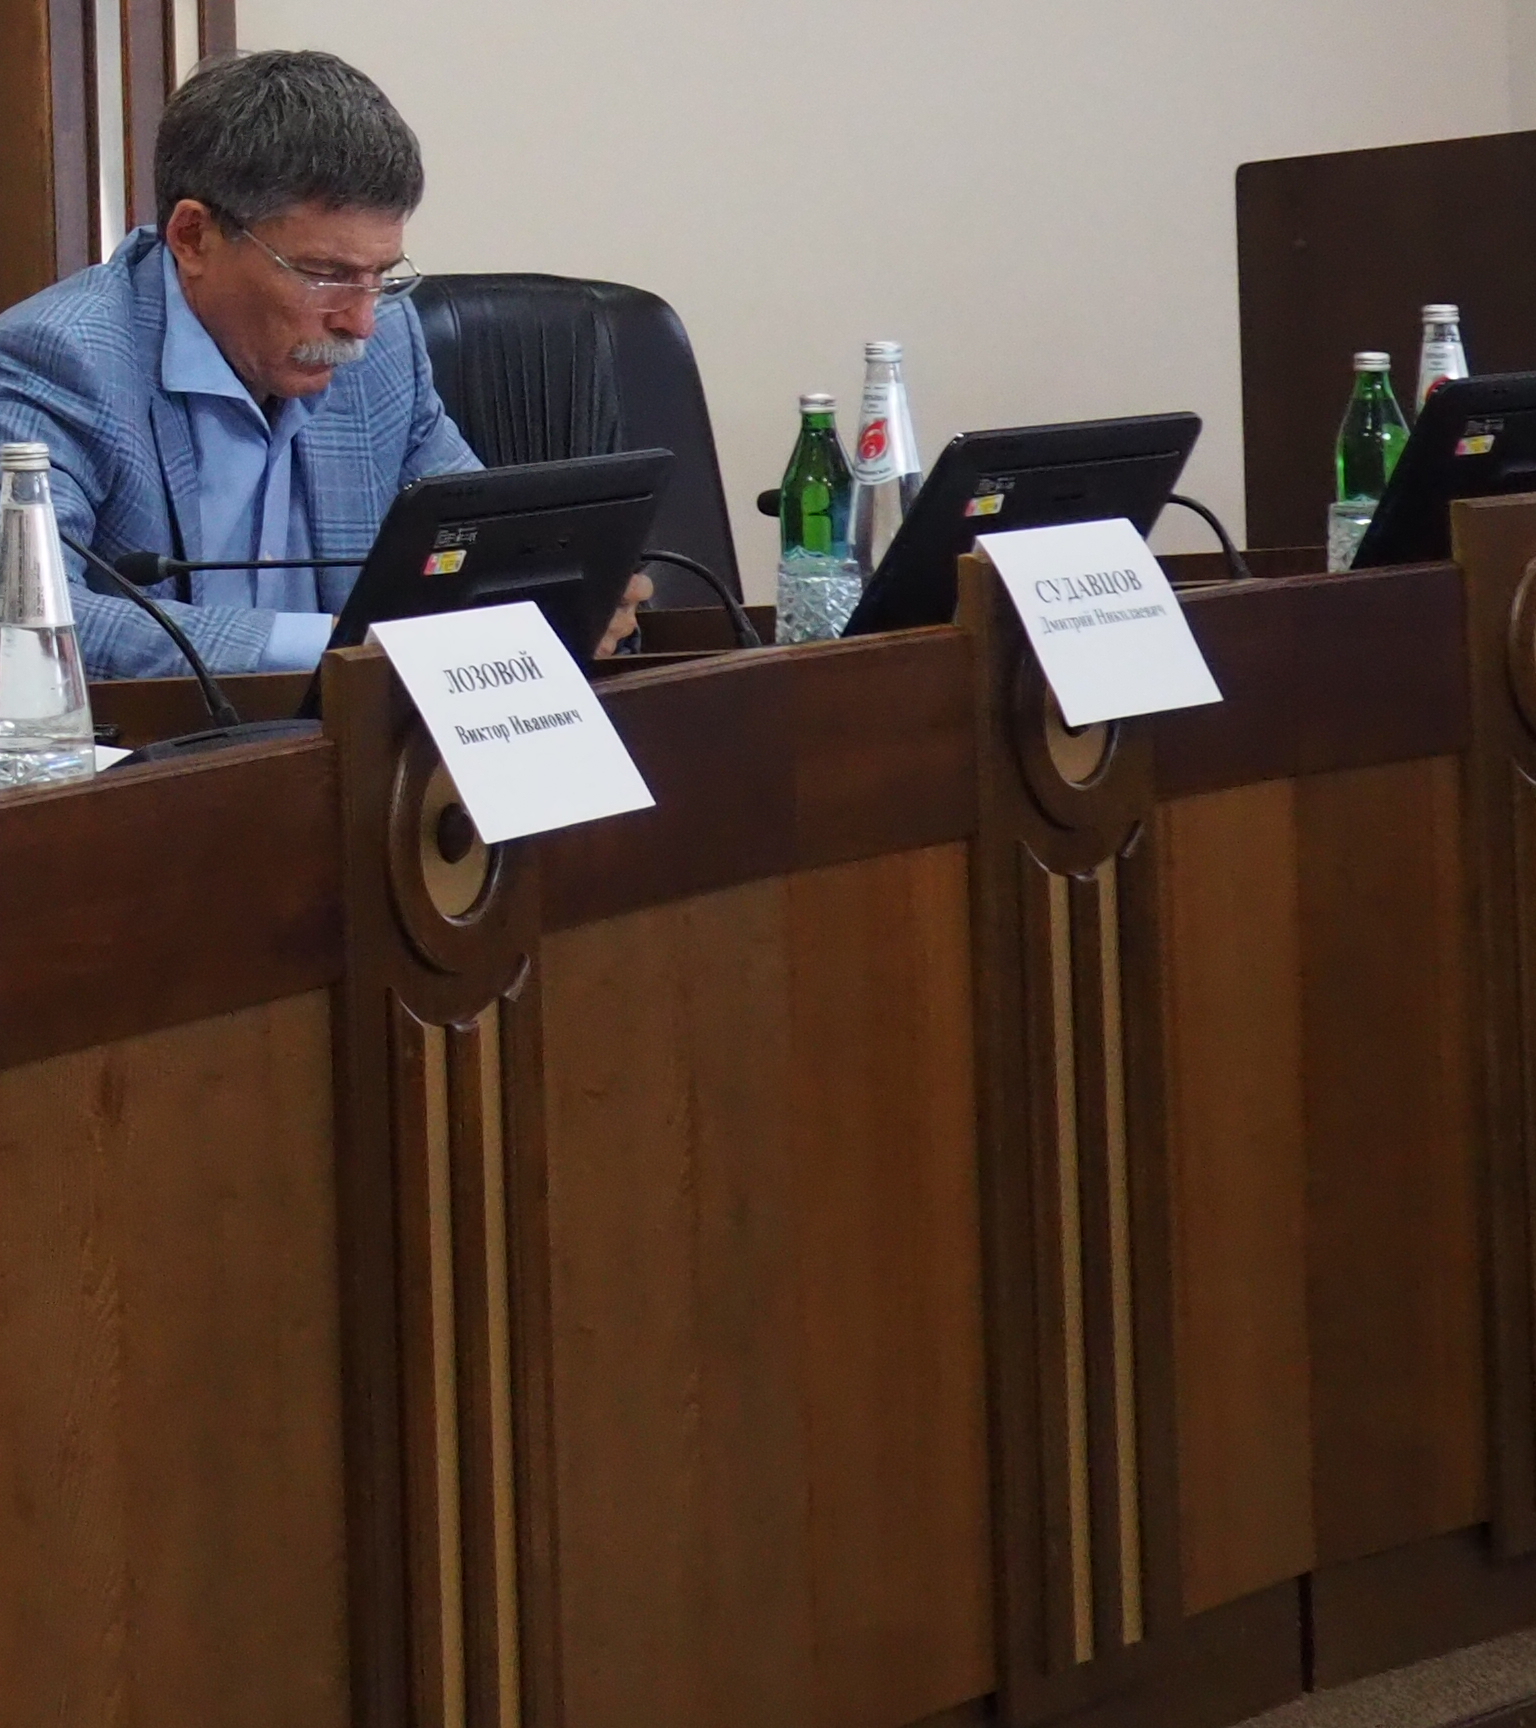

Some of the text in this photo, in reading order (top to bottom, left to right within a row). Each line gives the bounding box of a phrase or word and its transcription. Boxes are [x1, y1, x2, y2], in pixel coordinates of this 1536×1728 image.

[1035, 569, 1143, 604] СУДАВЦОВ
[1039, 611, 1095, 634] Дмитрий
[443, 650, 545, 694] ЛОЗОВОЙ
[454, 709, 583, 745] Виктор Иванович
